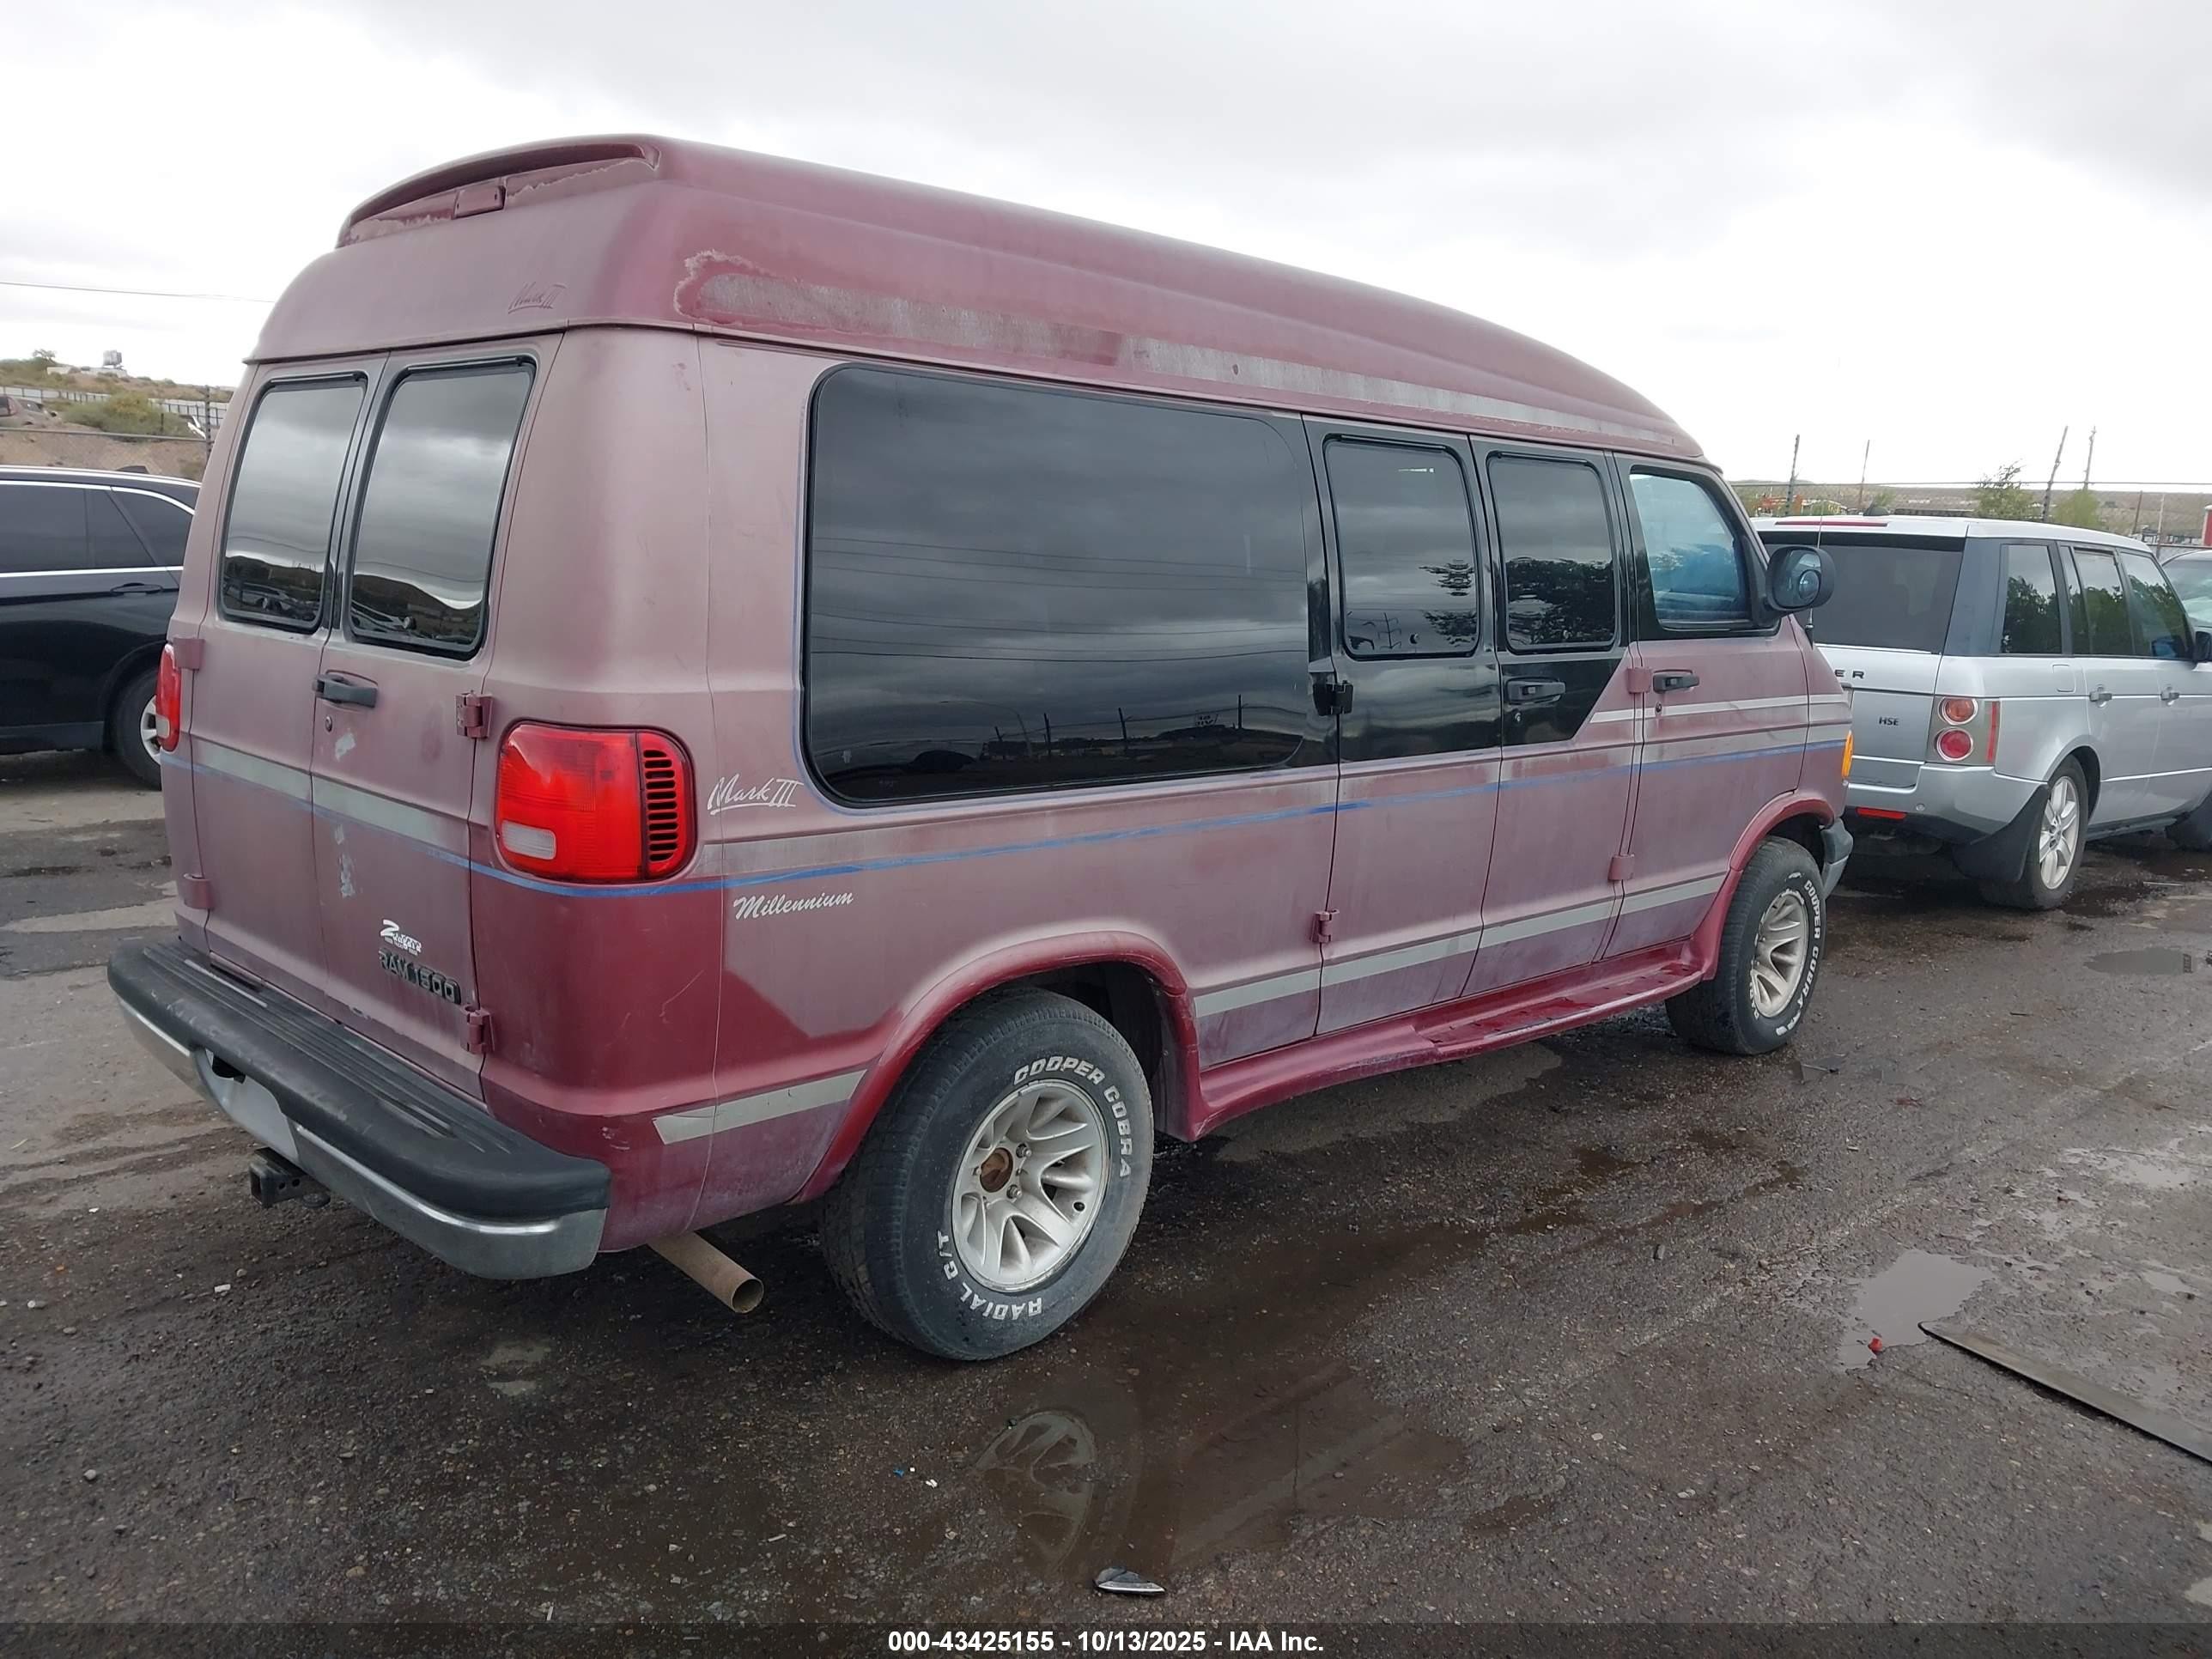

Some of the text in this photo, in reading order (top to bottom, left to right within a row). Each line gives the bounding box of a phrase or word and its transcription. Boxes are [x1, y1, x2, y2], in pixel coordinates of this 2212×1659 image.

[1879, 716, 1899, 726] HSE
[707, 773, 805, 814] Mark III
[733, 892, 854, 921] Millennium
[1797, 880, 1822, 1009] COOPER COBRA
[379, 948, 462, 1005] RAM 1500
[1013, 1055, 1135, 1178] COOPER COBRA
[936, 1230, 1043, 1321] RADIAL G/T
